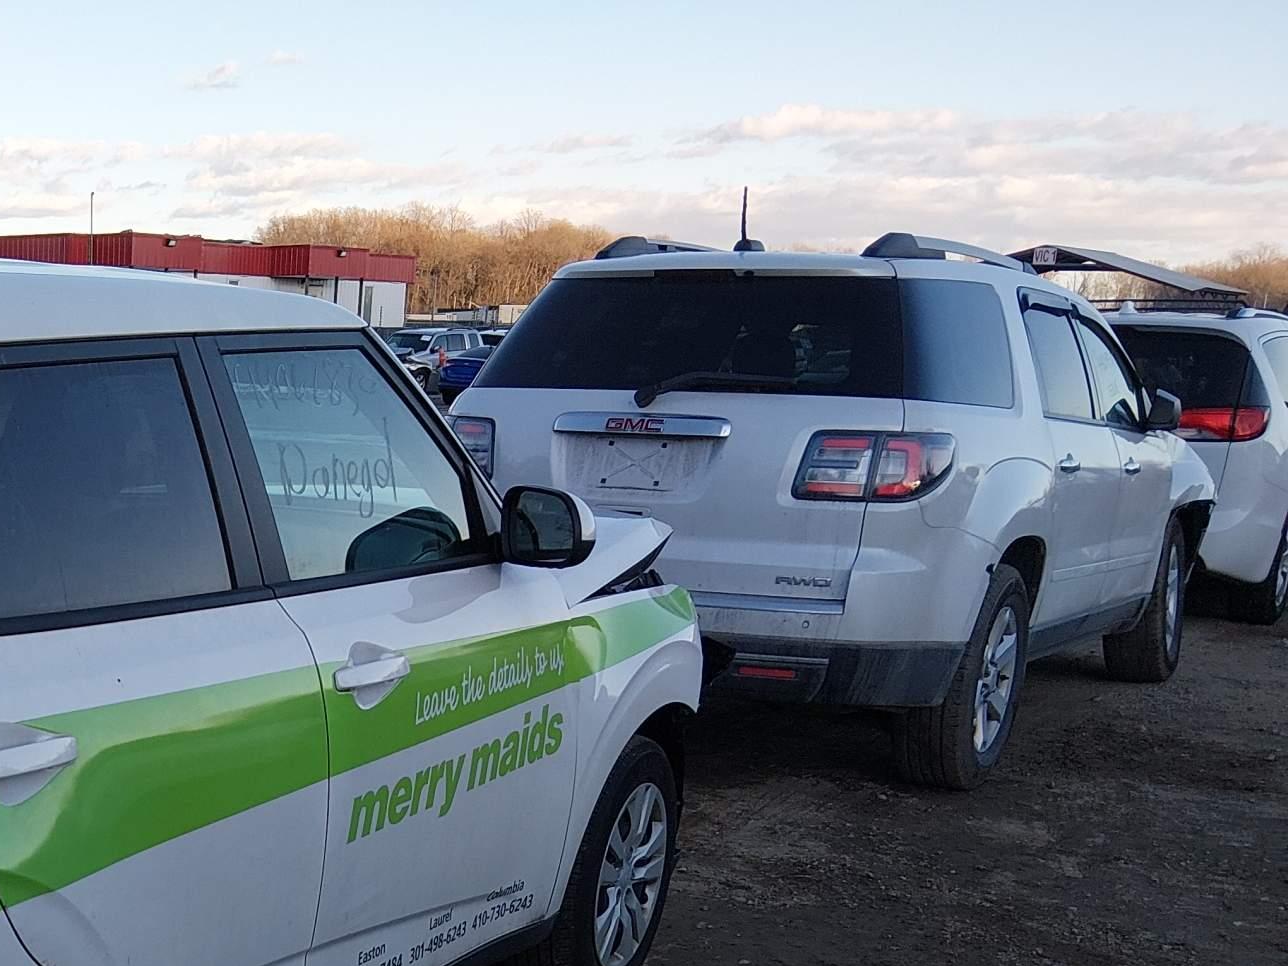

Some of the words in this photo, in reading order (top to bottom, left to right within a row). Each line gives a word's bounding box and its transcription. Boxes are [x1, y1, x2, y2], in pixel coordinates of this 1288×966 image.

[605, 416, 665, 433] GMC
[775, 576, 832, 588] AWD
[415, 691, 460, 725] Leave
[462, 664, 486, 705] the
[488, 646, 533, 696] details
[535, 646, 548, 677] to
[346, 752, 467, 845] merry
[466, 704, 563, 792] maids
[486, 879, 526, 902] Columbia
[429, 908, 454, 931] Laurel
[471, 893, 533, 930] 410-730-6243
[358, 943, 386, 966] Easton
[409, 921, 467, 965] 301-498-6243
